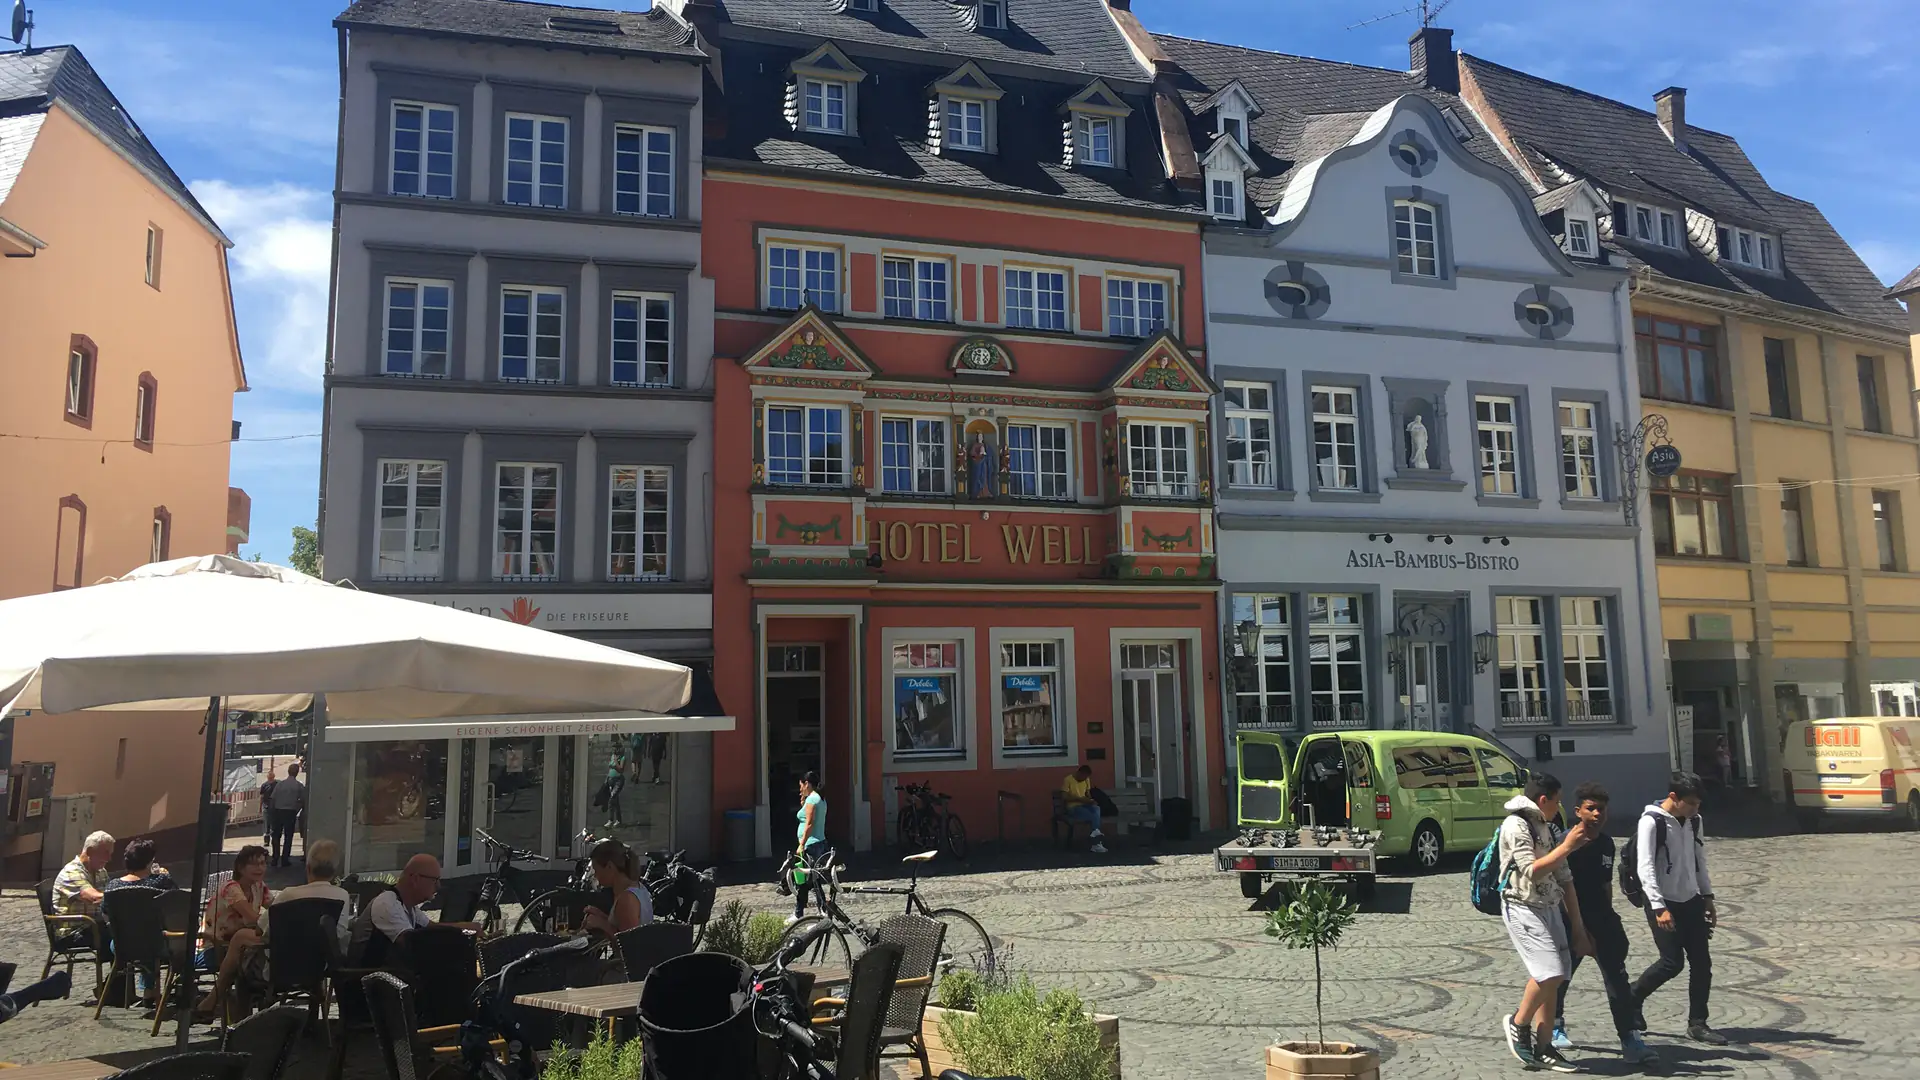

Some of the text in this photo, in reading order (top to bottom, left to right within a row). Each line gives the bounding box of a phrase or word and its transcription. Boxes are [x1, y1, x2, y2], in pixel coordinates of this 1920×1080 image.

[866, 520, 1101, 565] HOTEL WELL
[547, 612, 629, 622] DIE FRISEURE
[457, 727, 499, 736] EIGENE
[578, 723, 619, 732] ZEIGEN
[1805, 726, 1860, 747] Hall
